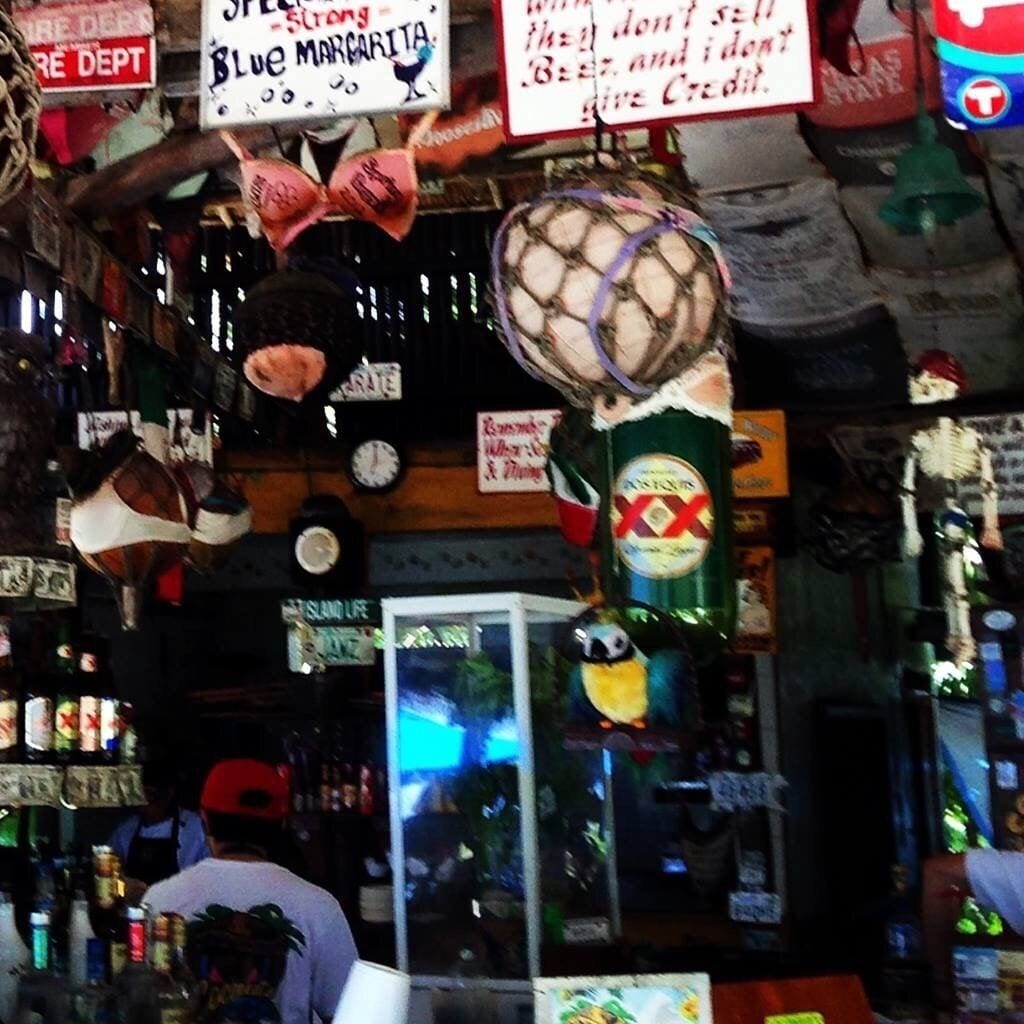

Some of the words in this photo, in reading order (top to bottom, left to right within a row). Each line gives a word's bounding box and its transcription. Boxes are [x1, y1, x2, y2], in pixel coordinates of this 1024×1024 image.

[295, 20, 431, 69] MARGARITA
[525, 20, 597, 53] they
[33, 49, 67, 80] RE
[78, 46, 146, 77] DEPT
[628, 37, 689, 74] and
[579, 87, 649, 124] give
